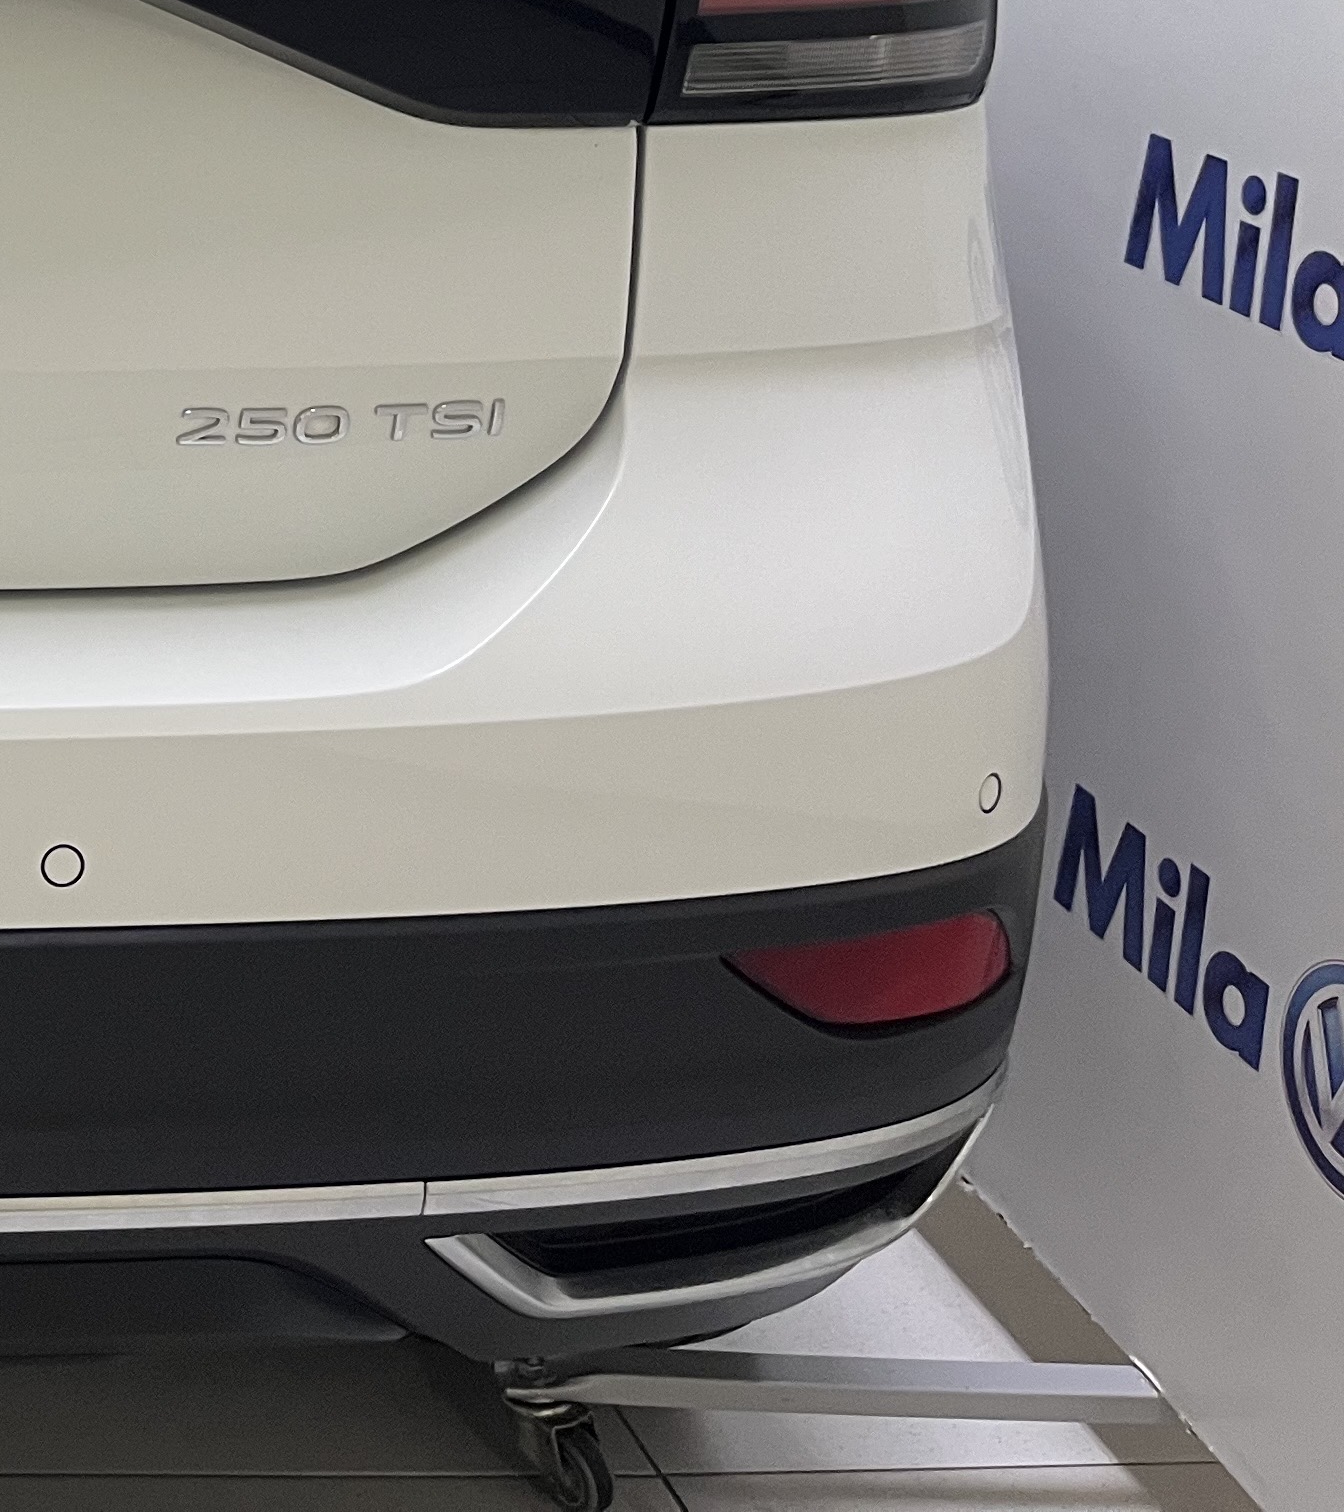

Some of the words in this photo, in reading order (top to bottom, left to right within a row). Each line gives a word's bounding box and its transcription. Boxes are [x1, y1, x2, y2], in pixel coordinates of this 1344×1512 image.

[1123, 133, 1344, 362] Mila
[175, 404, 351, 446] 250
[374, 397, 506, 442] TSI
[1053, 783, 1270, 1072] Mila
